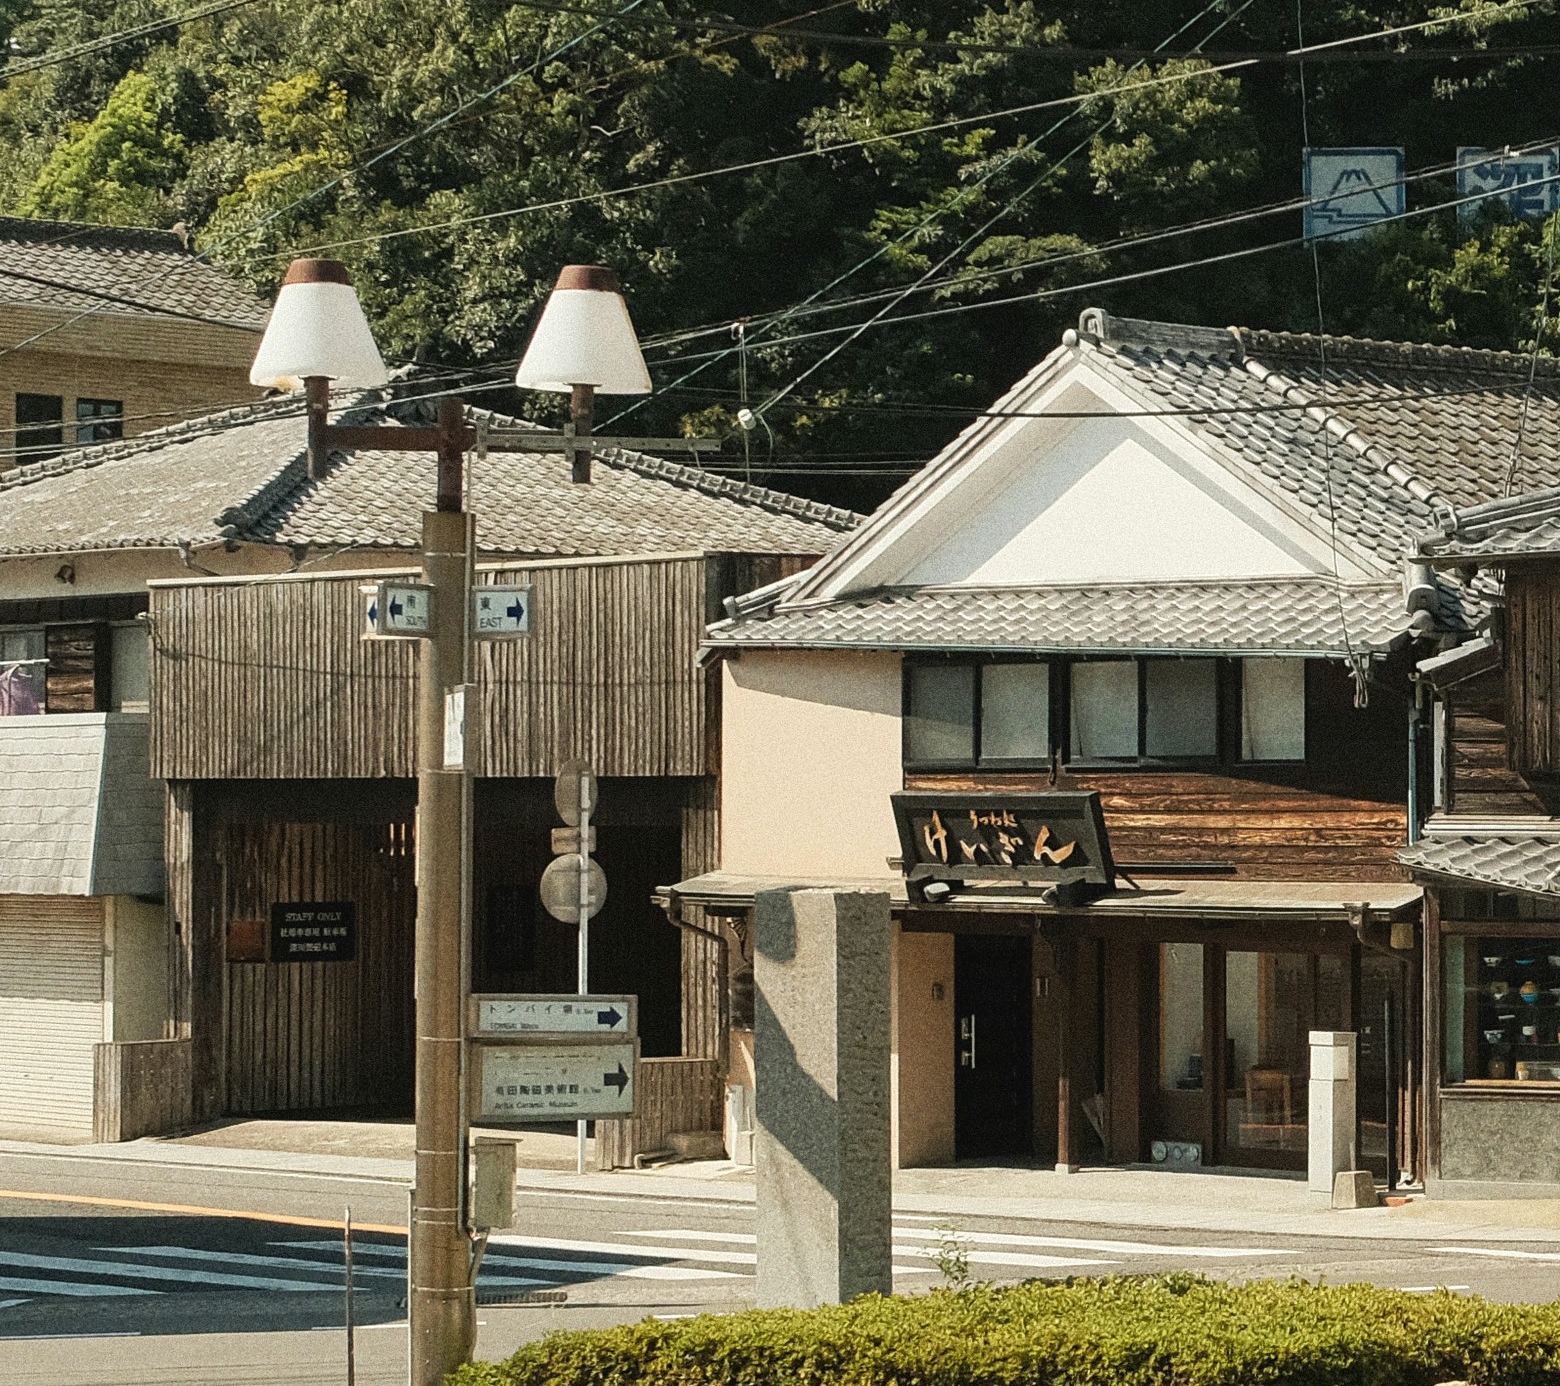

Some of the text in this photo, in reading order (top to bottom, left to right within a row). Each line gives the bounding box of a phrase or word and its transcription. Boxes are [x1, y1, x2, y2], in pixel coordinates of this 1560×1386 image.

[479, 617, 503, 629] EAST
[285, 912, 342, 922] STAFF ONLY
